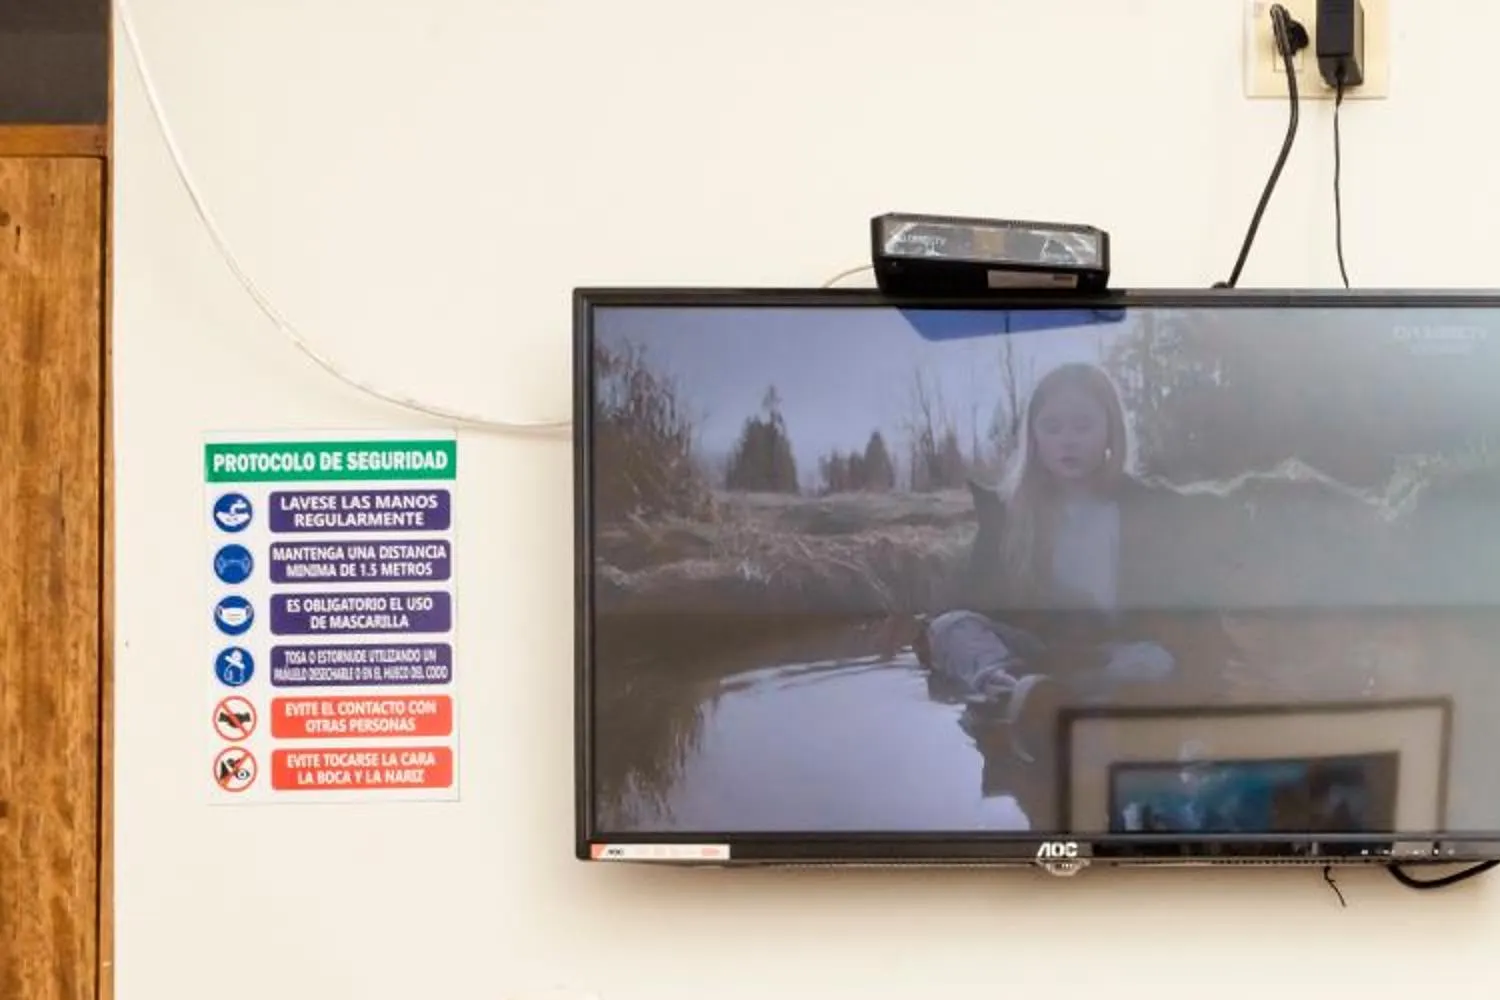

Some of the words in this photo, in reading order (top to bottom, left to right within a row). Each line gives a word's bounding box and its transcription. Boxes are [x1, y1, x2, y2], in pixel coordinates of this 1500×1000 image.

[213, 453, 315, 472] PROTOCOLO
[319, 454, 343, 471] DE
[347, 450, 448, 470] SEGURIDAD
[281, 496, 337, 510] LAVESE
[341, 495, 371, 510] LAS
[375, 494, 438, 509] MANOS
[294, 511, 425, 527] REGULARMENTE
[273, 547, 345, 561] MANTENGA
[348, 546, 376, 560] UNA
[379, 545, 447, 559] DISTANCIA
[286, 564, 337, 578] MINIMA
[340, 563, 357, 577] DE
[361, 562, 377, 577] 1.5
[381, 561, 433, 576] METROS
[286, 599, 301, 613] ES
[303, 598, 387, 612] OBLIGATORIO
[390, 597, 404, 611] EL
[407, 596, 433, 611] USO
[310, 615, 328, 630] DE
[330, 613, 409, 629] MASCARILLA
[285, 651, 307, 664] TOSA
[309, 651, 316, 663] O
[318, 650, 367, 663] ESTORNUDE
[424, 648, 437, 662] UN
[285, 702, 318, 715] EVITE
[321, 702, 334, 715] EL
[337, 701, 404, 715] CONTACTO
[408, 701, 436, 714] CON
[305, 719, 347, 732] OTRAS
[350, 717, 416, 732] PERSONAS
[287, 754, 321, 767] EVITE
[323, 753, 378, 766] TOCARSE
[381, 753, 397, 766] LA
[400, 752, 435, 766] CARA
[297, 771, 314, 785] LA
[317, 770, 351, 784] BOCA
[353, 770, 361, 783] Y
[365, 769, 382, 783] LA
[384, 769, 424, 783] NARIZ
[1037, 841, 1078, 857] AOC
